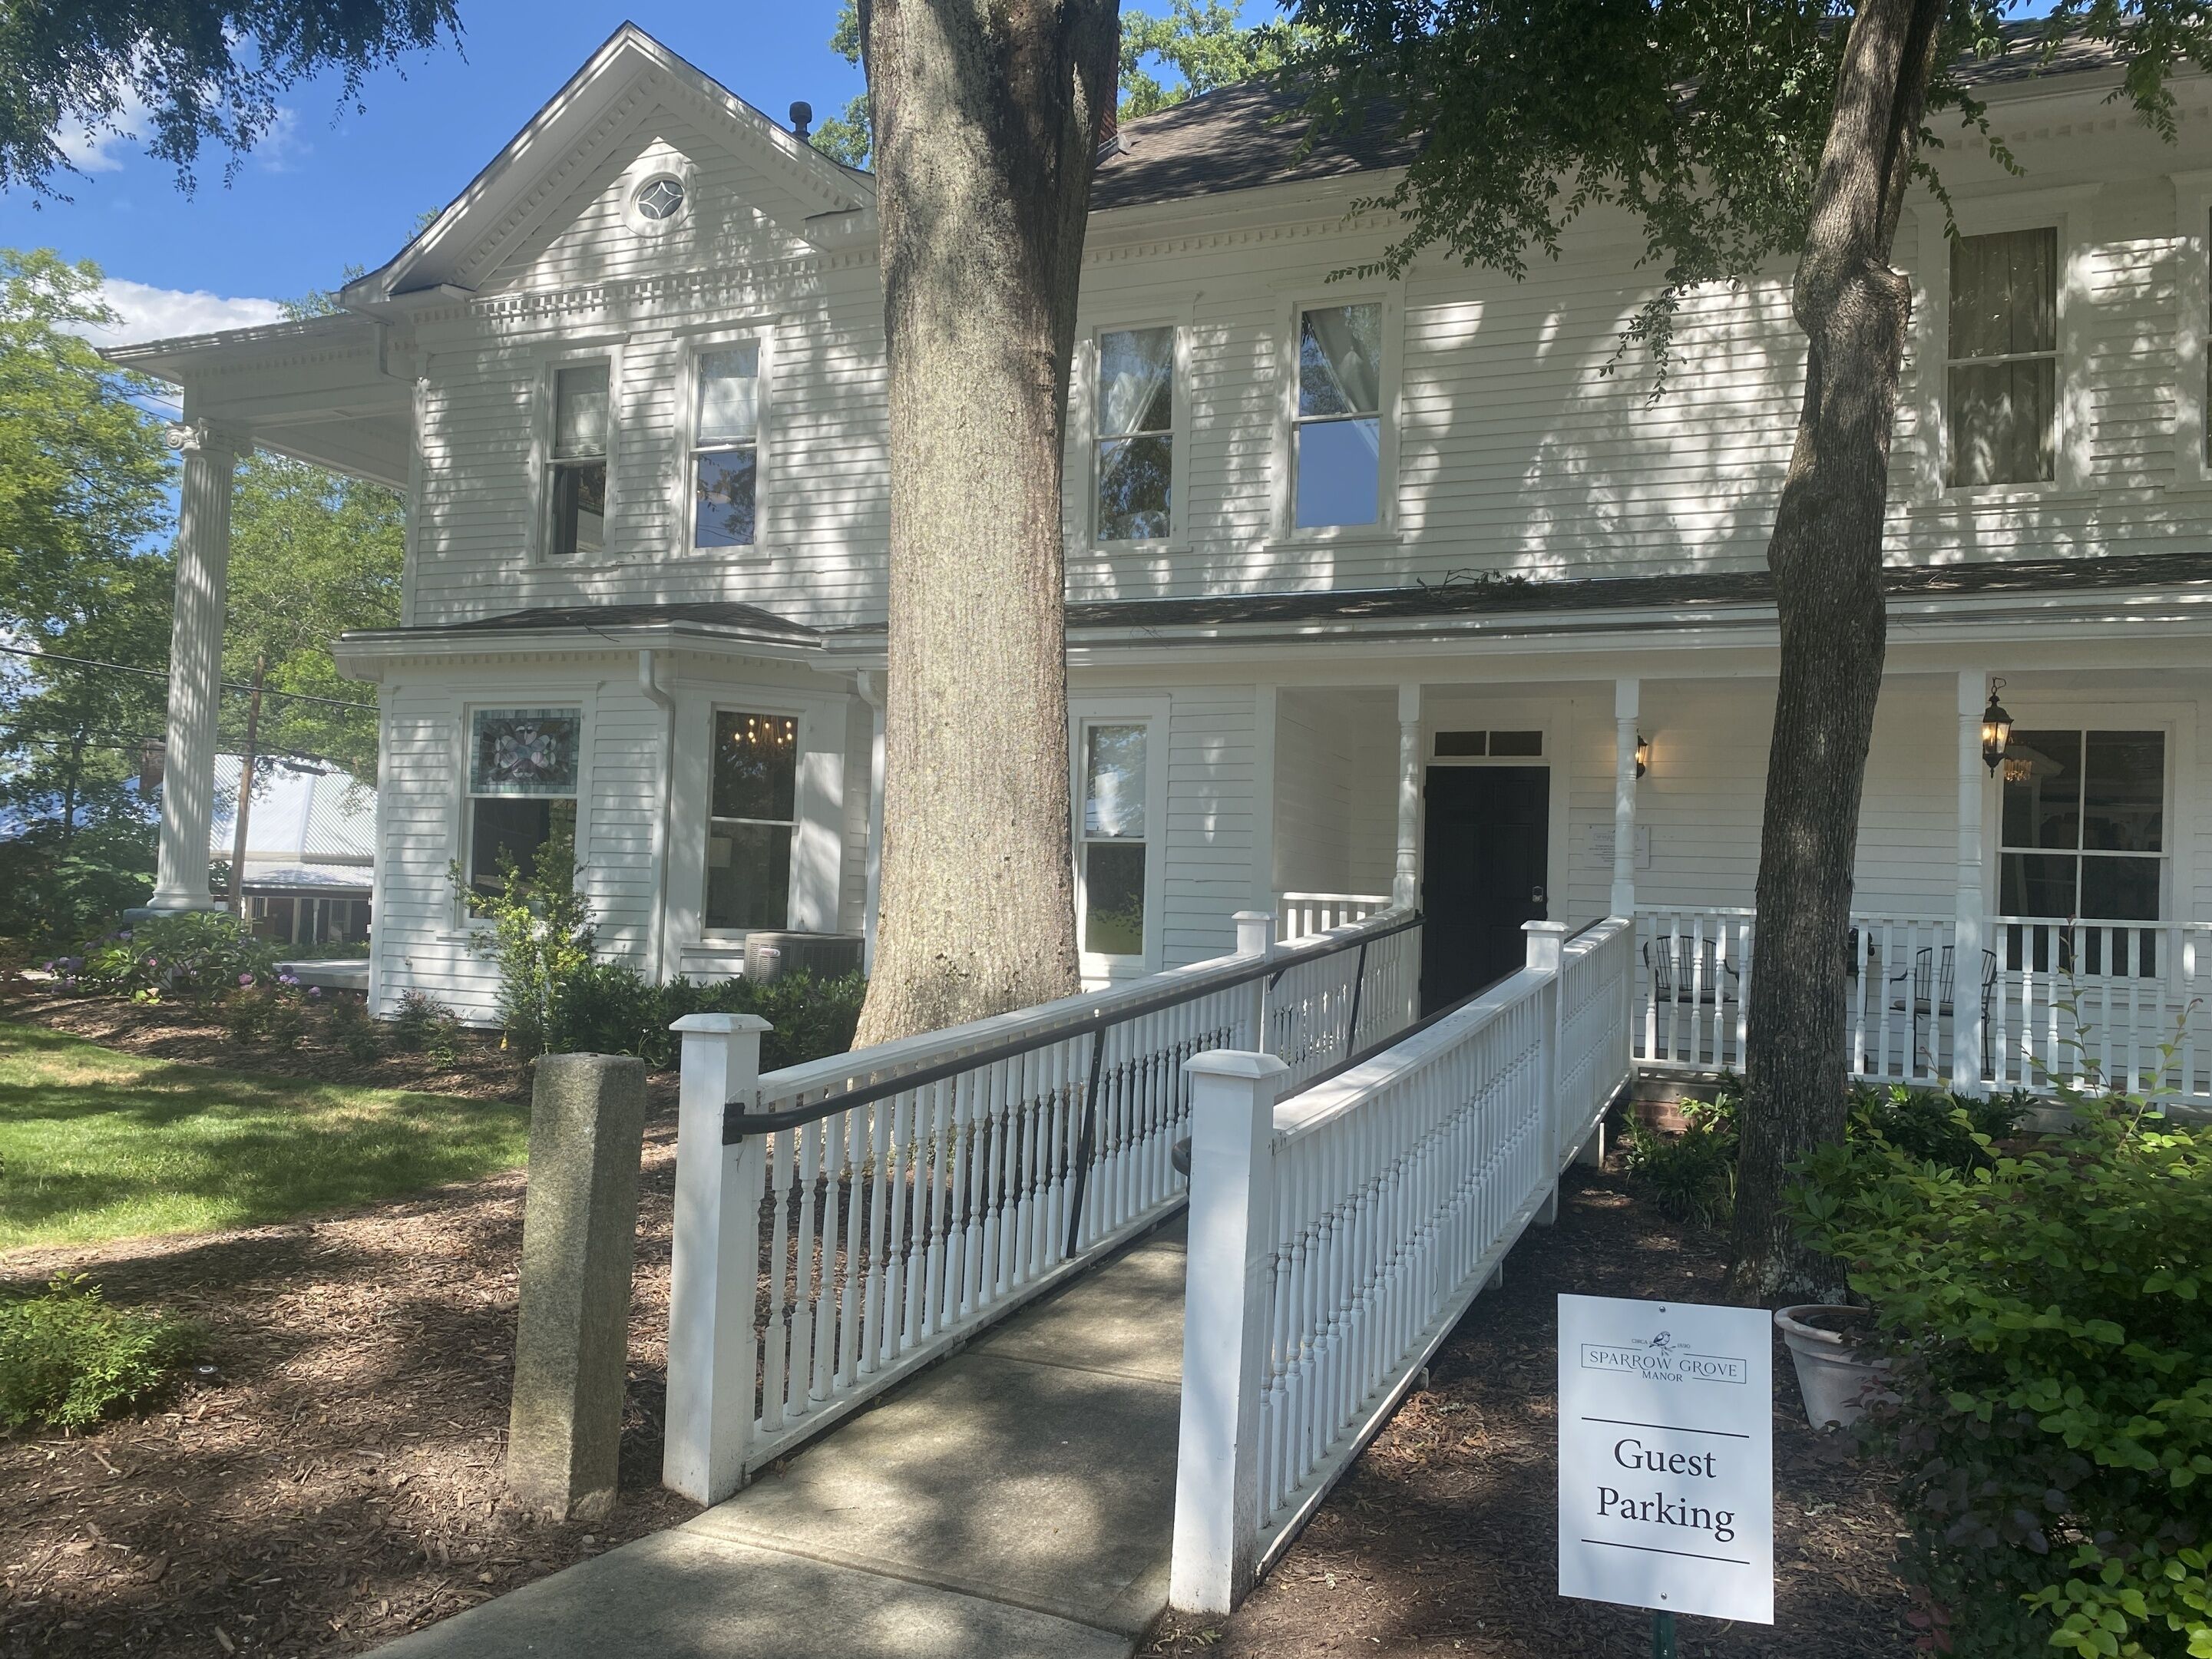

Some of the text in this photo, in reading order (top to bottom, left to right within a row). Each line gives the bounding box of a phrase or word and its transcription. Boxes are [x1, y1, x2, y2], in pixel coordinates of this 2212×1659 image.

[1589, 1351, 1737, 1377] SPARROW GROVE
[1642, 1370, 1683, 1382] MANOR
[1614, 1439, 1717, 1479] Guest
[1597, 1486, 1735, 1543] Parking
